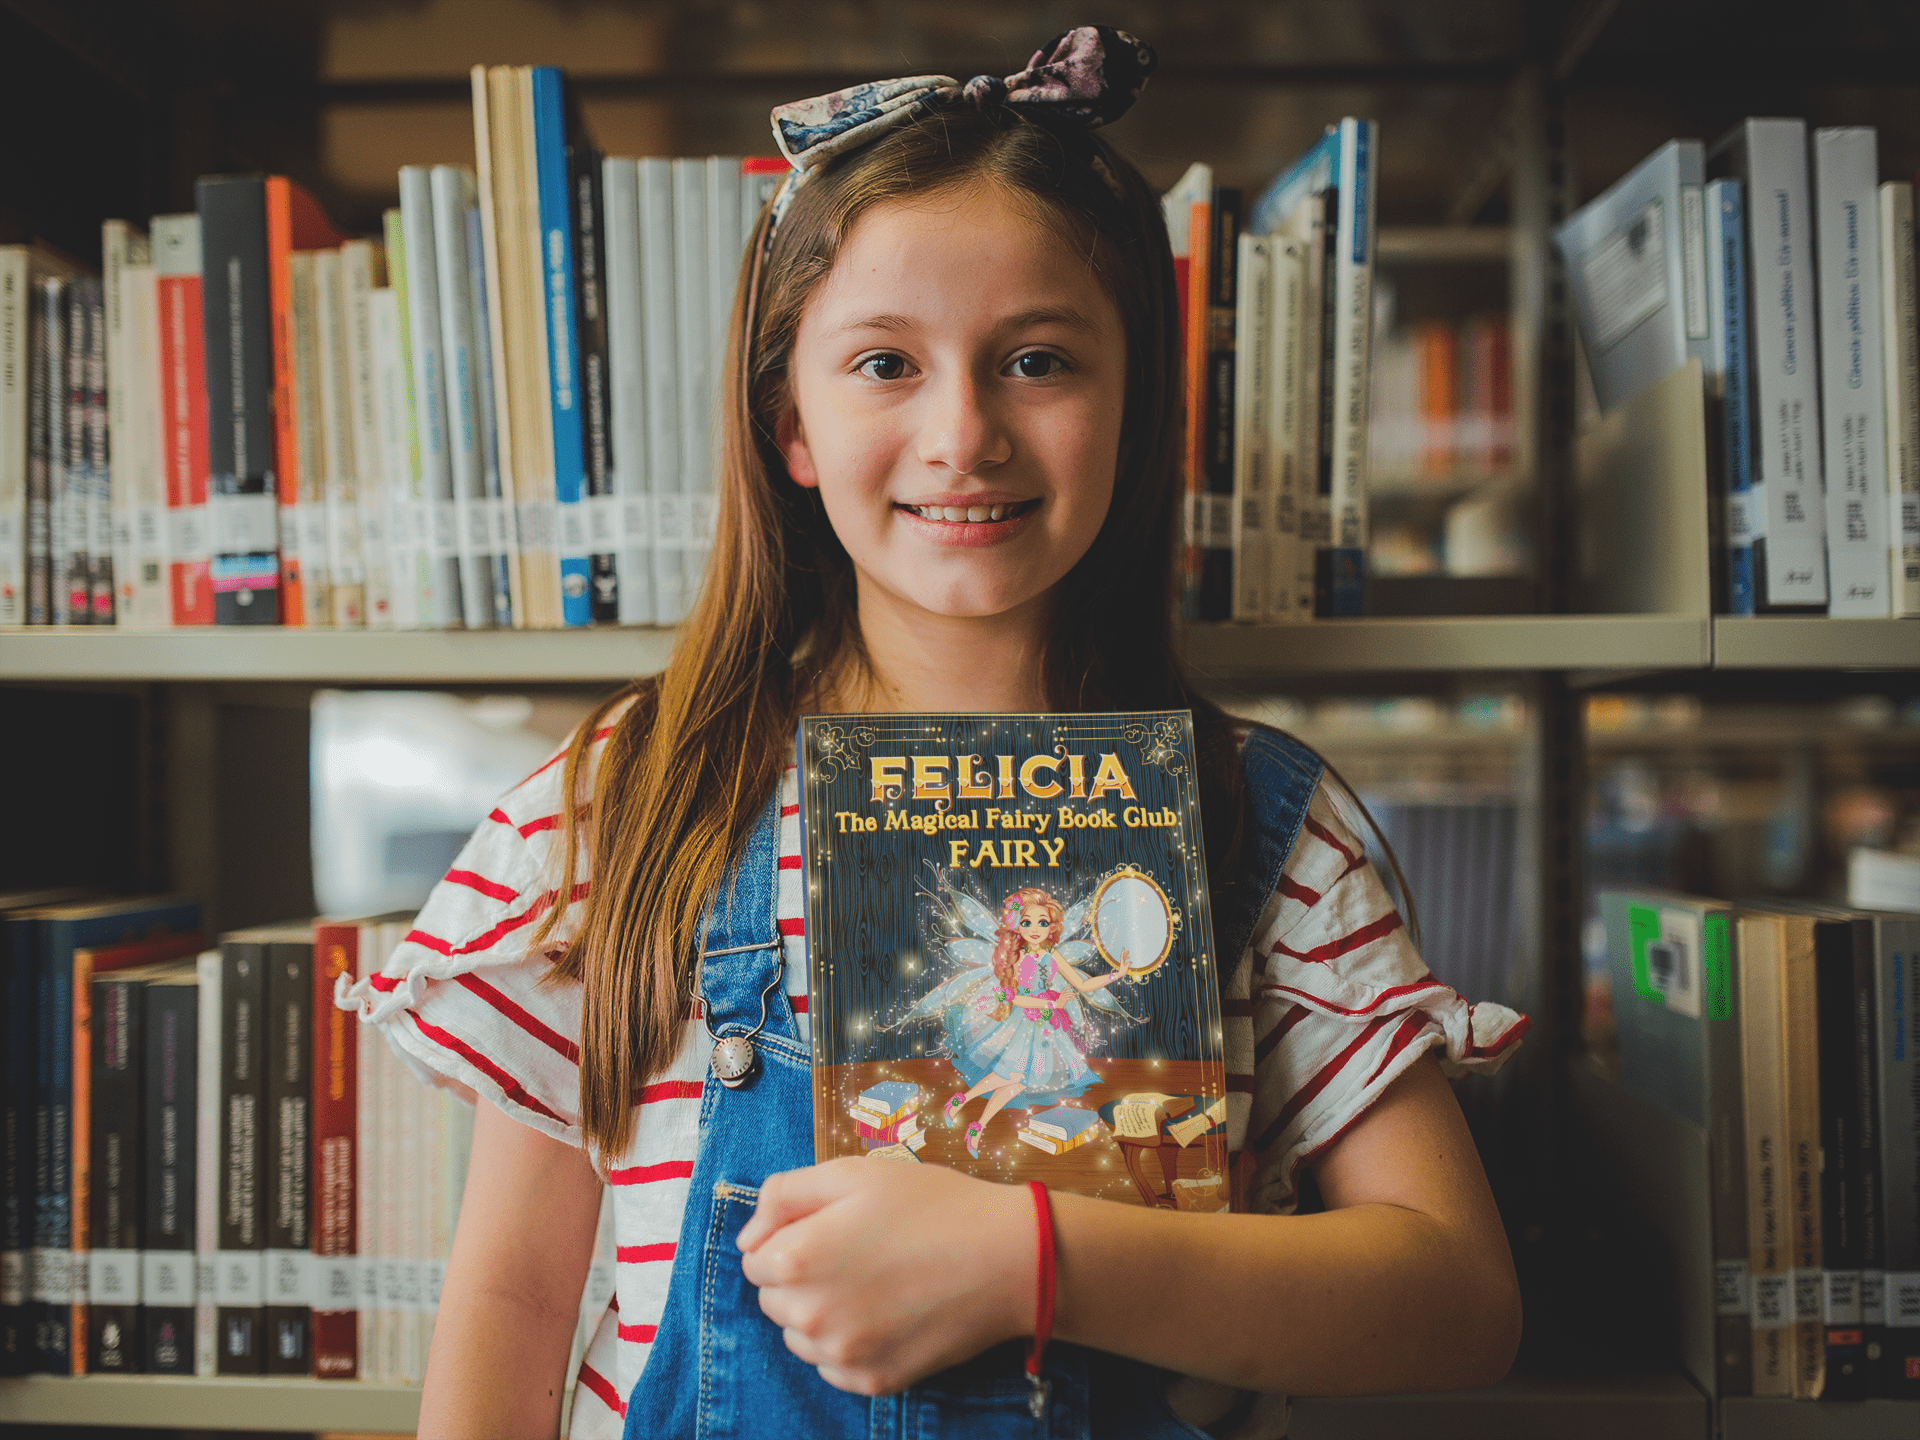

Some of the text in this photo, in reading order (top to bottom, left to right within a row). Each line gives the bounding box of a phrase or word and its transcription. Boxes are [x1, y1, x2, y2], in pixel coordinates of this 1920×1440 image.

[869, 744, 1139, 812] FELICIA
[835, 807, 1178, 836] The Magical Fairy Book Club
[949, 837, 1065, 869] FAIRY
